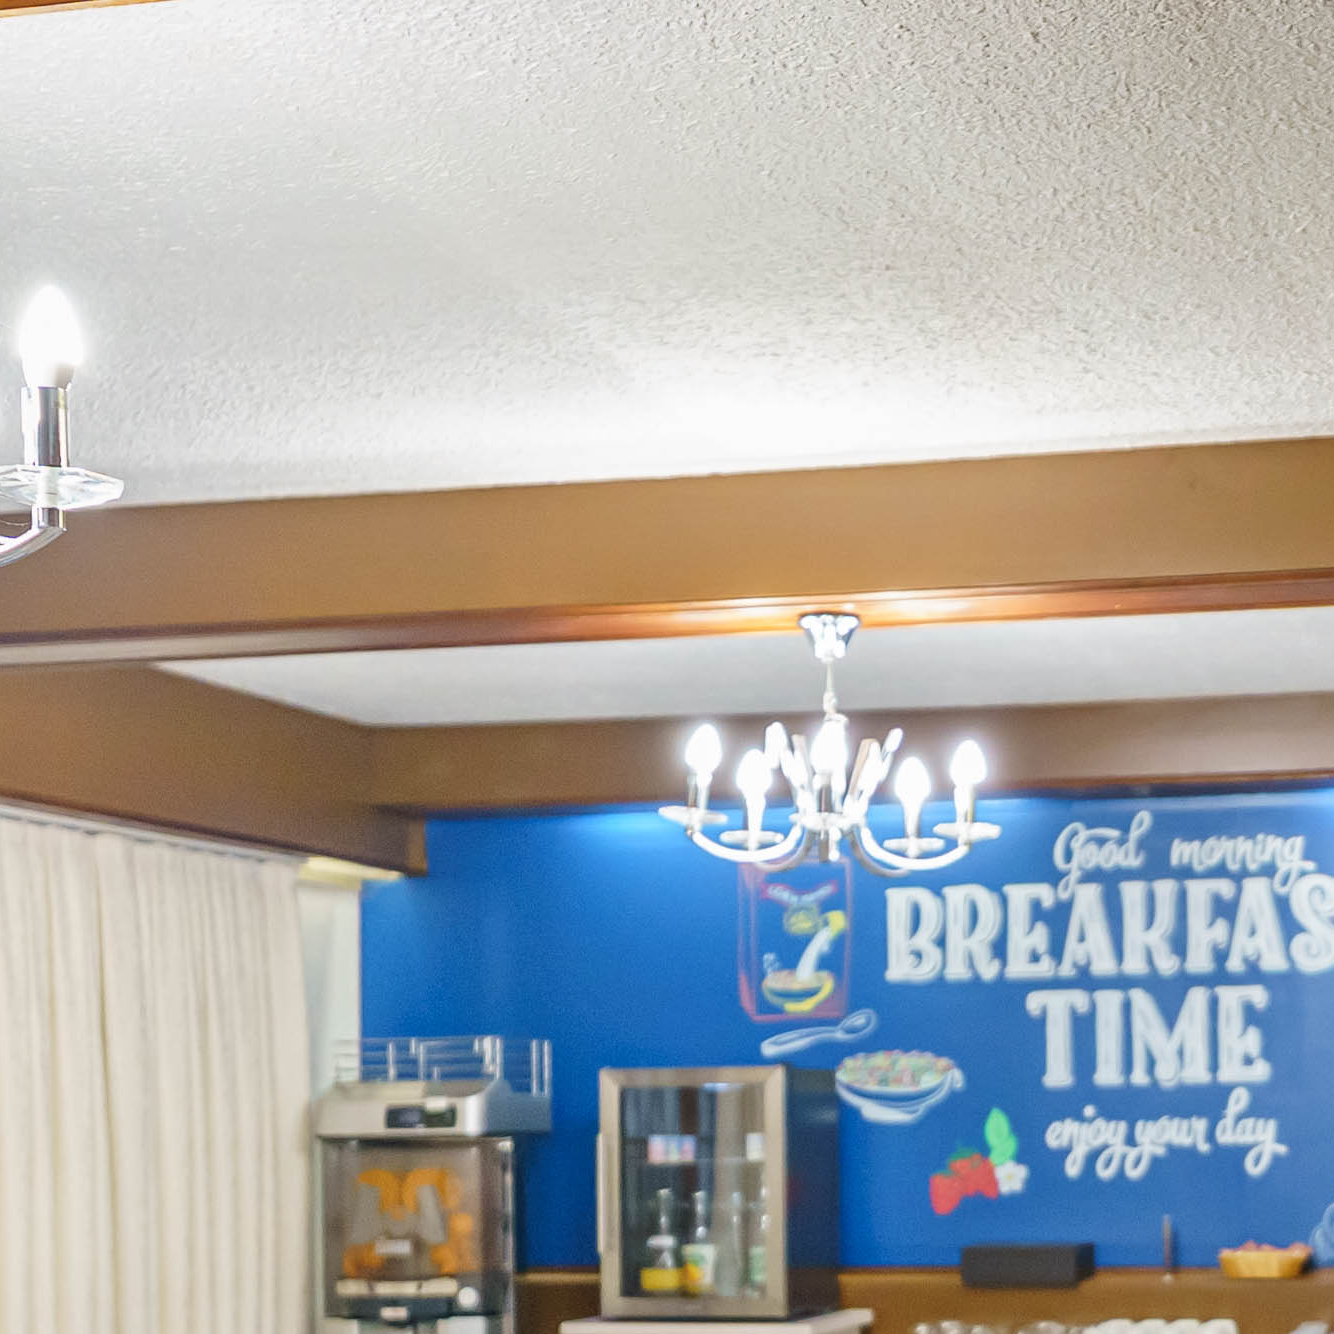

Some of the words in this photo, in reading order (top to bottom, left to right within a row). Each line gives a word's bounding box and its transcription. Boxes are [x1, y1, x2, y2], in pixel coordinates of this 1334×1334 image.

[1053, 810, 1153, 897] Good
[1169, 830, 1317, 893] morning
[1024, 984, 1273, 1088] TIME
[1045, 1105, 1128, 1180] enjoy
[1124, 1114, 1211, 1180] your
[1215, 1087, 1289, 1177] day
